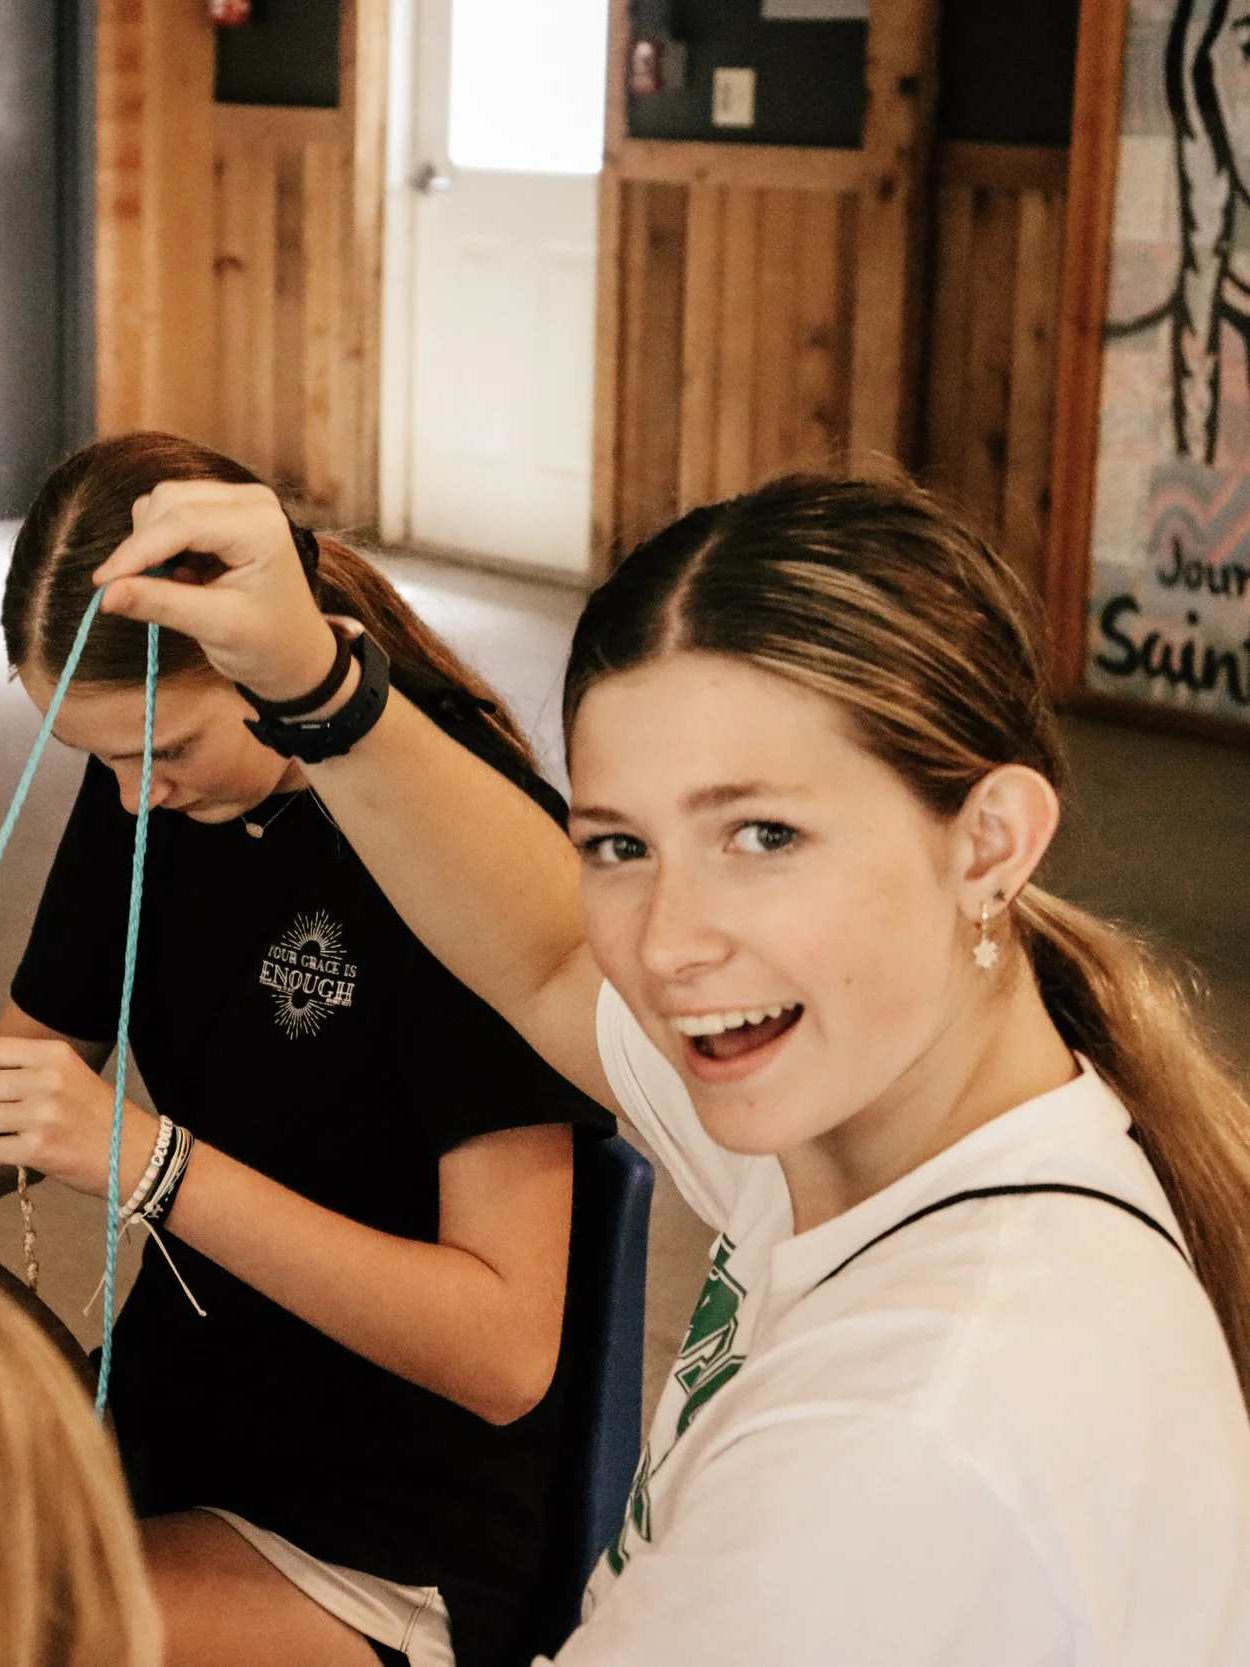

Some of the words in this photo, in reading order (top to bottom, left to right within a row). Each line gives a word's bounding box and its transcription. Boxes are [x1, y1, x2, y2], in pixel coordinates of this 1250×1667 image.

[1096, 594, 1250, 704] Sain
[259, 959, 355, 1003] ENOUGH
[268, 944, 297, 965] YOUR
[300, 954, 341, 975] GRACE
[343, 963, 358, 978] IS
